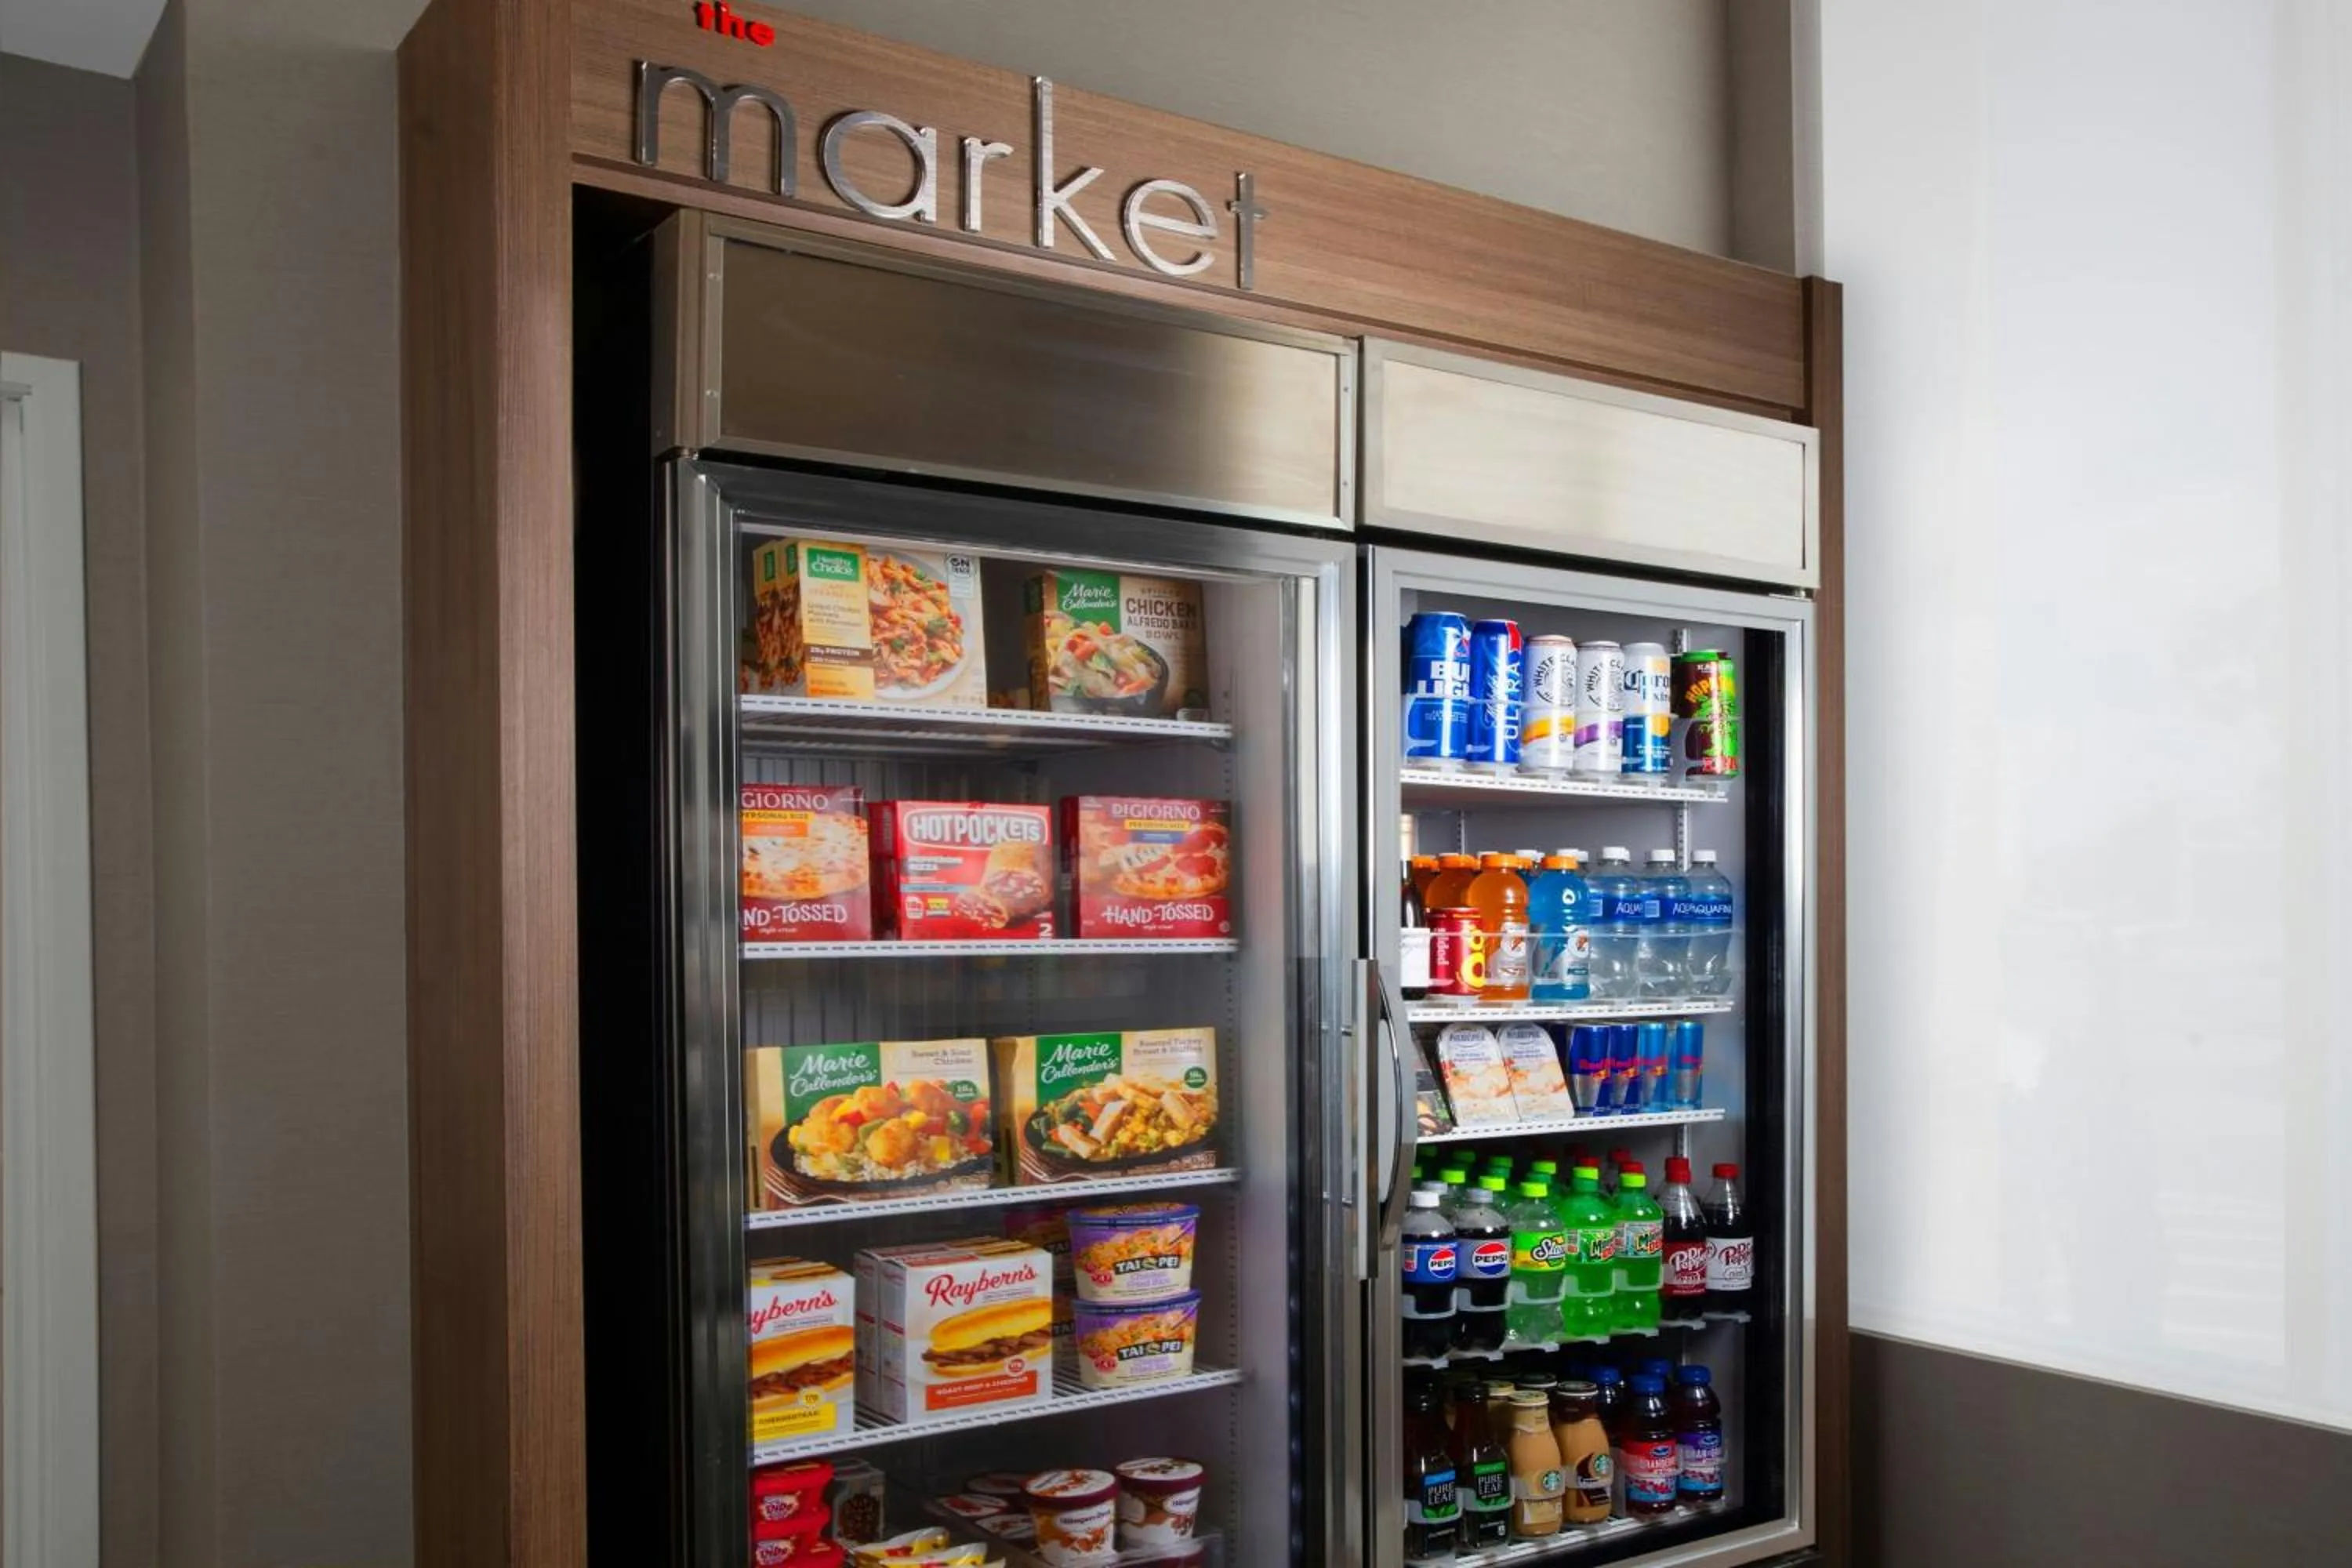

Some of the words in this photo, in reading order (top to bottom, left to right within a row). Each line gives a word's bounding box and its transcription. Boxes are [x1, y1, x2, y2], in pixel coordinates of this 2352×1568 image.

[695, 1, 776, 47] the
[633, 59, 1269, 291] market
[811, 560, 854, 576] Choice
[1062, 583, 1112, 598] Marie
[1125, 598, 1197, 617] CHICKEN
[1126, 616, 1171, 628] ALFREDO
[912, 816, 954, 842] HOT
[958, 815, 1041, 844] POCKETS
[1039, 923, 1053, 938] 2
[1040, 1042, 1112, 1067] Marie
[790, 1050, 870, 1080] Marie
[1040, 1058, 1120, 1085] Callender's
[789, 1069, 877, 1098] Callender's
[1116, 1259, 1141, 1273] TAI
[1158, 1256, 1178, 1269] PEI
[925, 1263, 1037, 1308] Raybern's
[1120, 1346, 1144, 1359] TAI
[1161, 1341, 1181, 1353] PEI
[1478, 1473, 1503, 1486] PURE
[1427, 1481, 1454, 1497] PURE
[1479, 1483, 1503, 1496] LEAF
